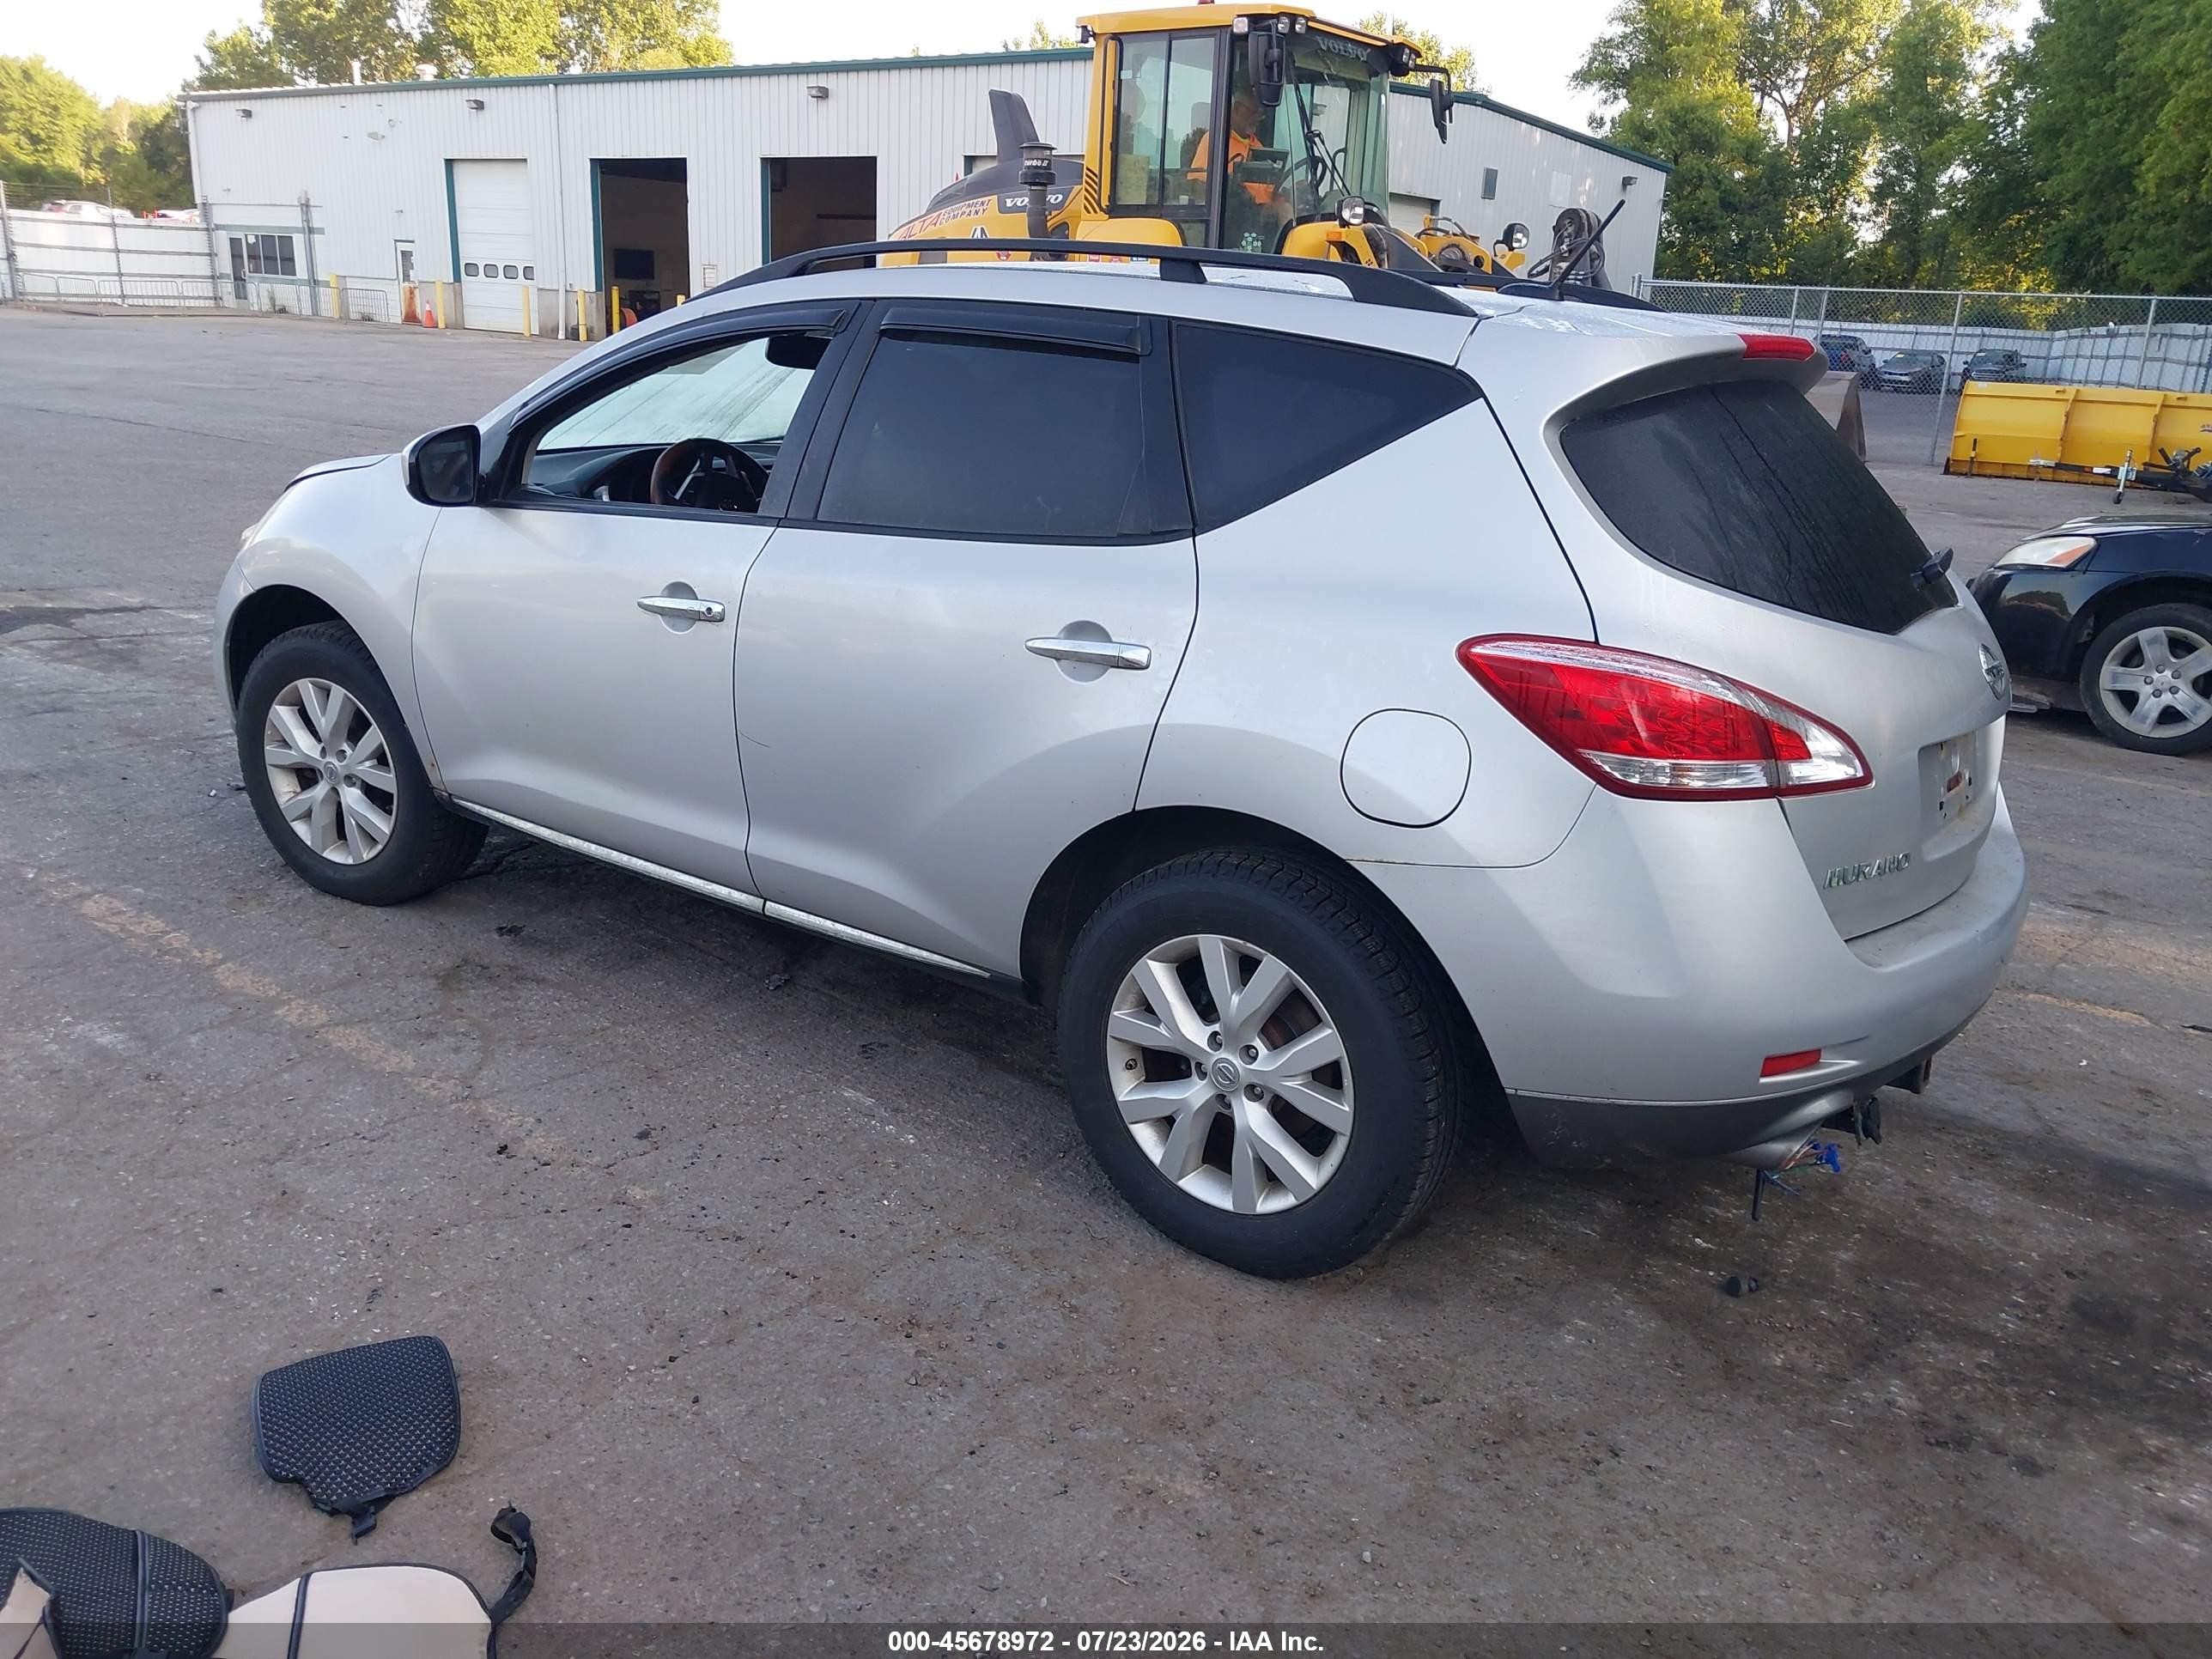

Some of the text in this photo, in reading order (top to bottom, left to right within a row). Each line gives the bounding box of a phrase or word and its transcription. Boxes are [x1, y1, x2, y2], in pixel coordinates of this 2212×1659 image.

[1316, 35, 1371, 62] VOLVO
[944, 198, 993, 216] EQUIPMENT
[1005, 193, 1063, 207] VOO
[898, 211, 943, 240] ALTA
[939, 207, 988, 225] COMPANY
[1823, 852, 1910, 890] MURANO
